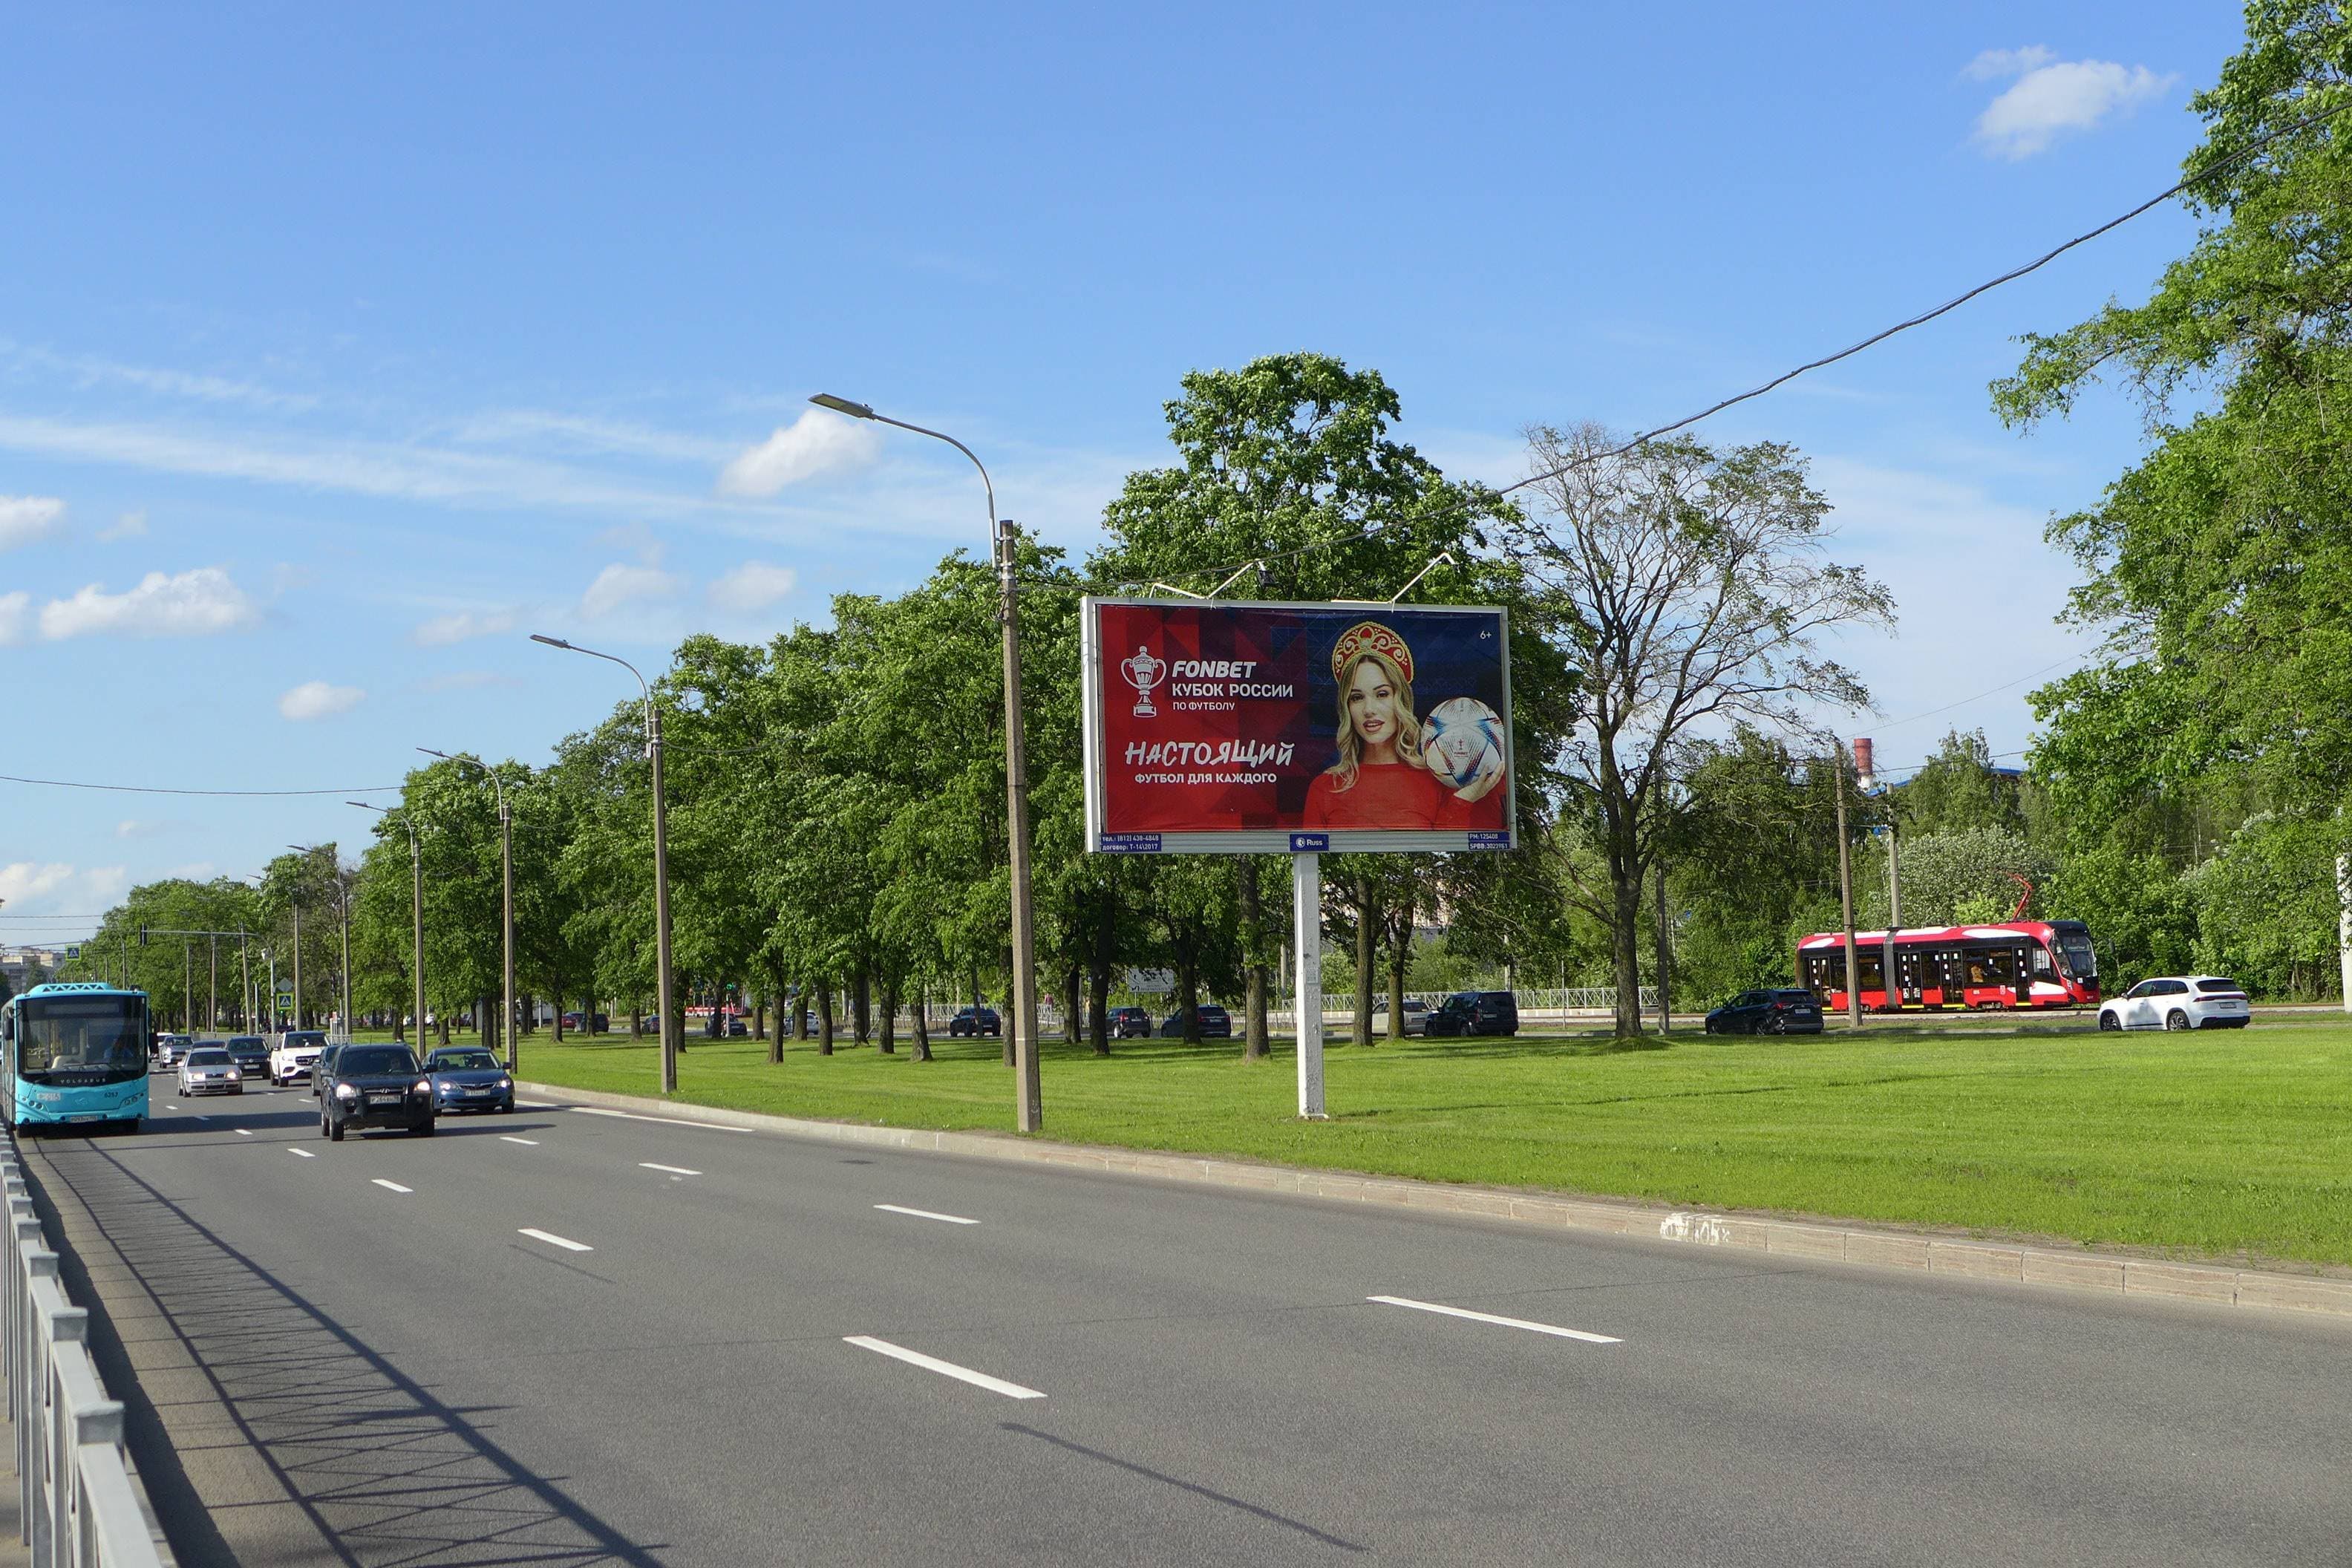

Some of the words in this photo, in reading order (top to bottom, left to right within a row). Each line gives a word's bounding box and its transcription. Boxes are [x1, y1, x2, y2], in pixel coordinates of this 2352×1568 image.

[1480, 630, 1492, 639] 6+
[1172, 660, 1257, 679] FONBET
[1172, 683, 1224, 696] КУБОК
[1229, 683, 1293, 697] РОССИИ
[1173, 702, 1186, 710] ПО
[1188, 701, 1235, 710] ФУТБОЛУ
[1125, 739, 1295, 768] НАСТОЯЩИЙ
[1134, 773, 1184, 783] ФУТБОЛ
[1187, 773, 1212, 784] ДЛЯ
[1216, 773, 1277, 784] КАЖДОГО
